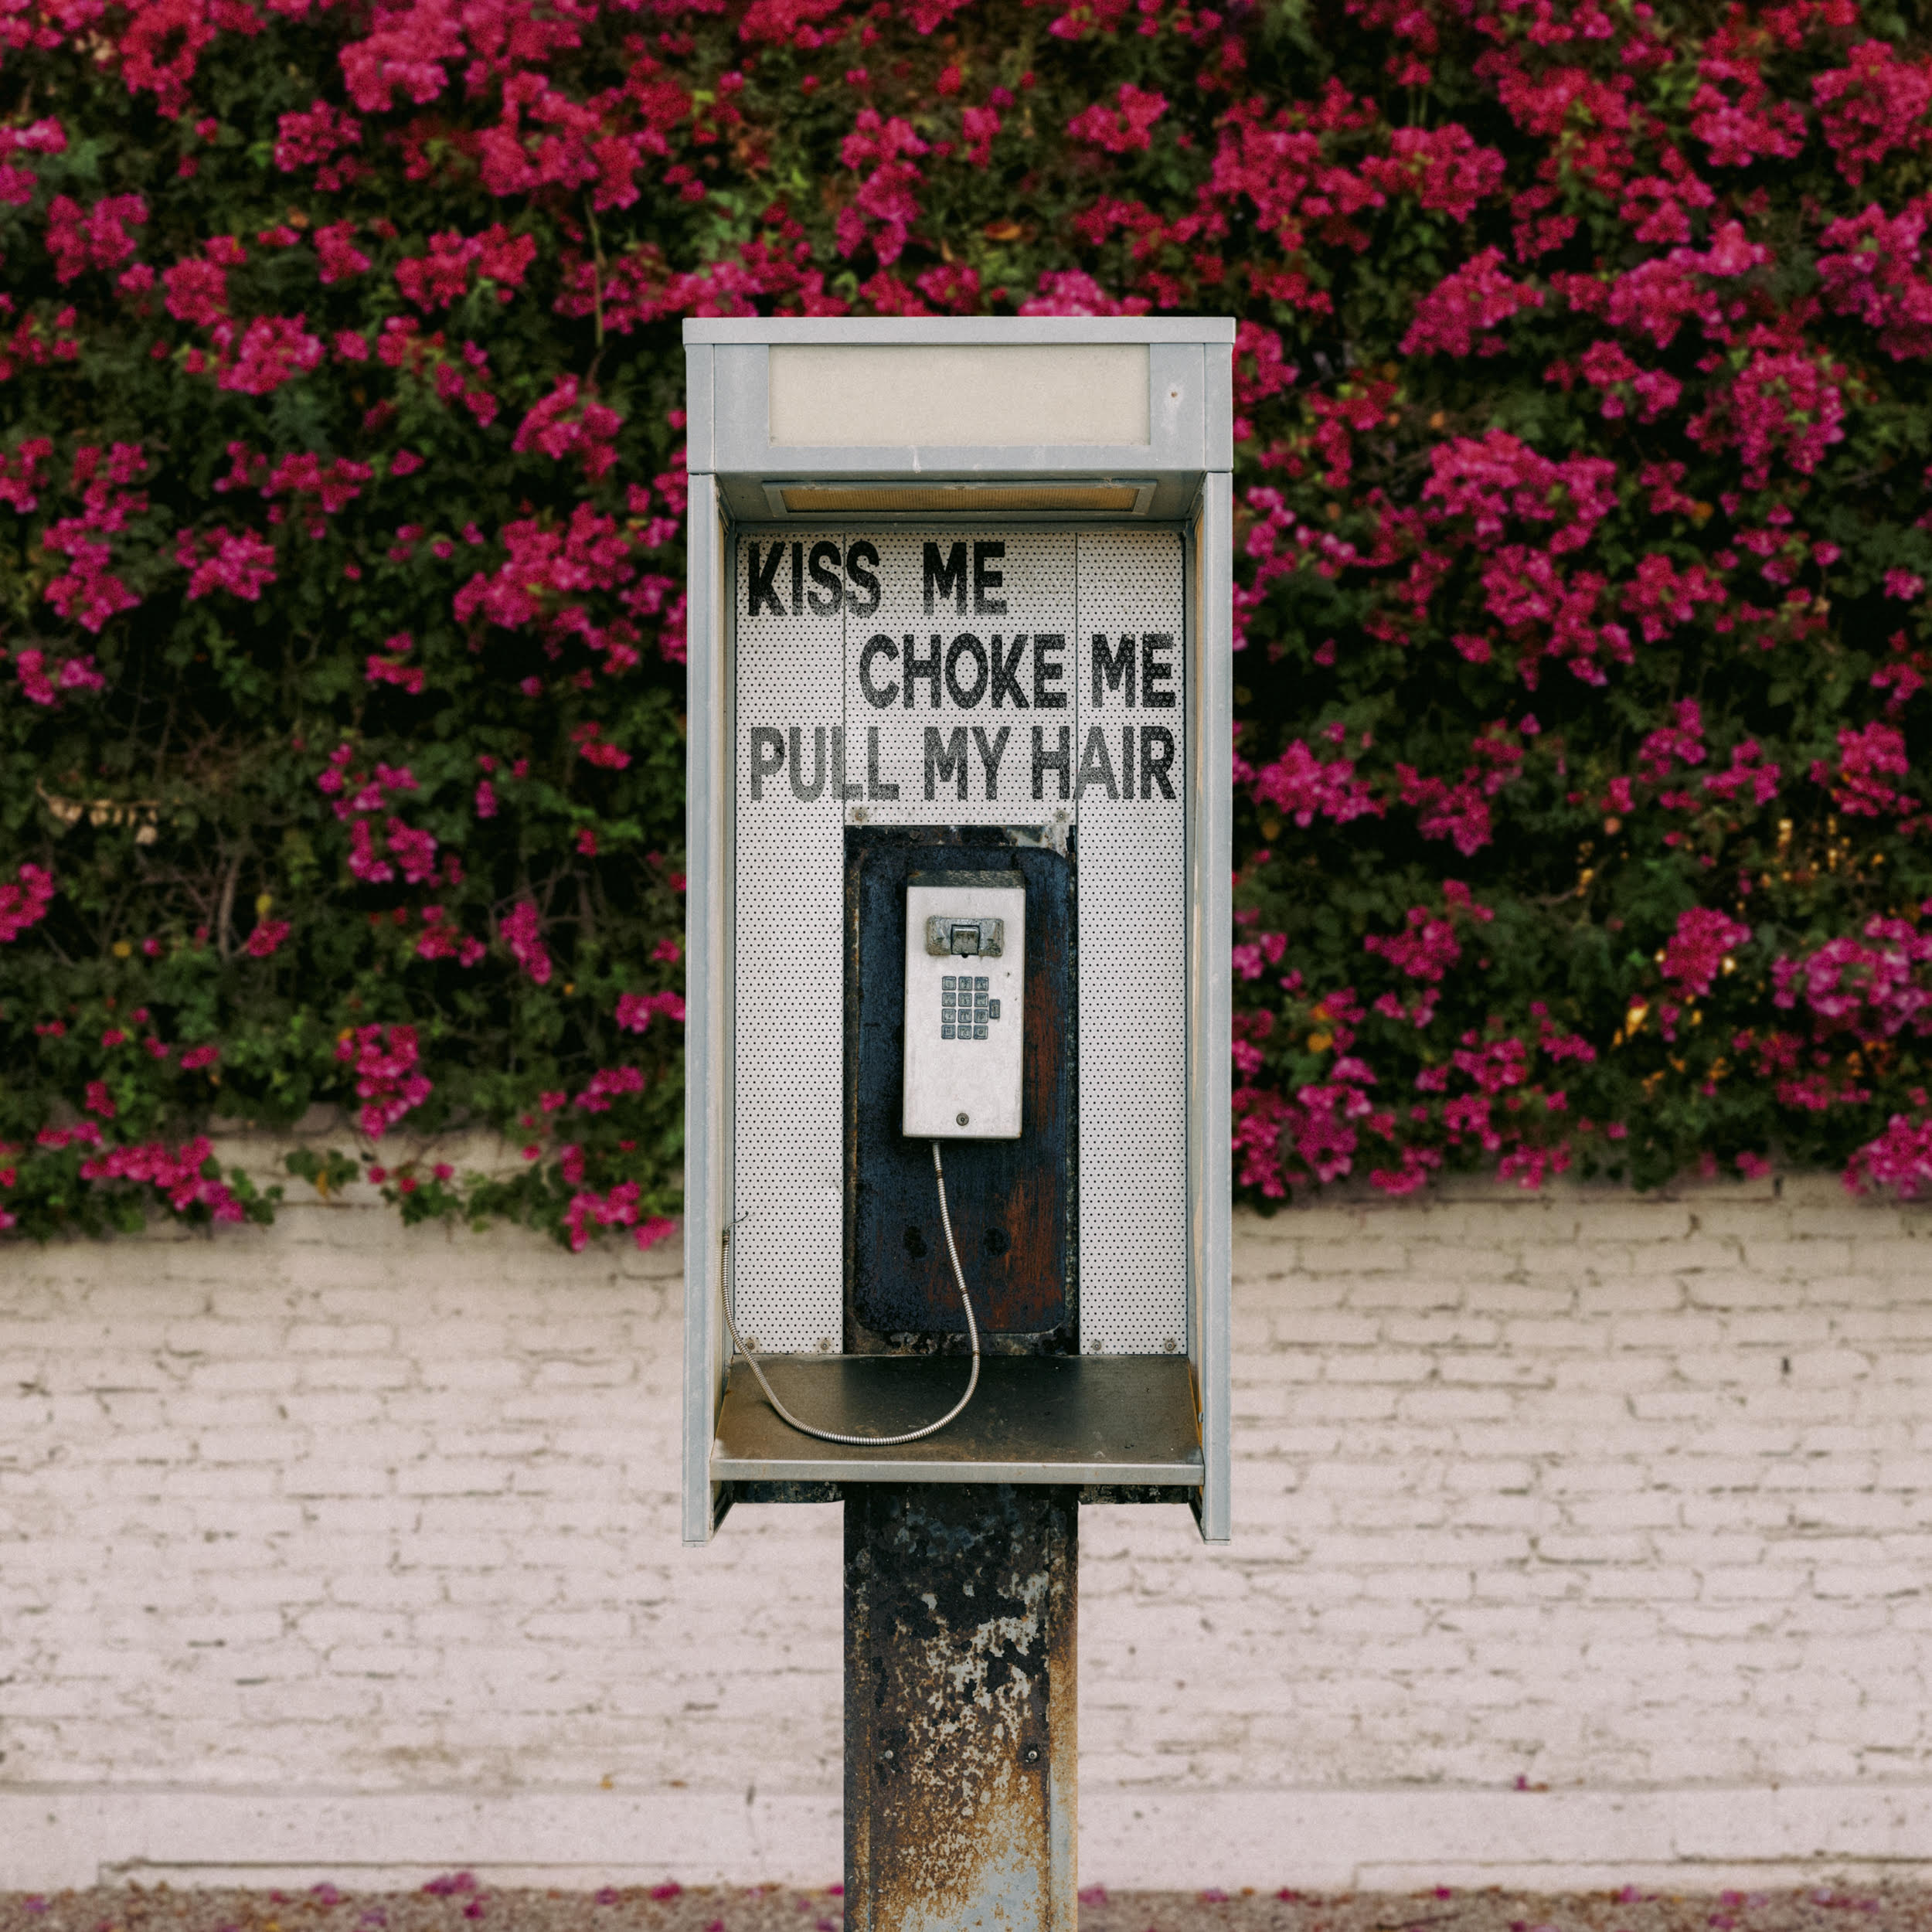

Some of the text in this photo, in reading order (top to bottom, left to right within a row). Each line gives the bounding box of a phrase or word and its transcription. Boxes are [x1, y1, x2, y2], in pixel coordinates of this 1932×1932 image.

[747, 541, 1007, 617] KISS ME
[859, 633, 1176, 709] CHOKE ME
[750, 726, 1176, 801] PULL MY HAIR
